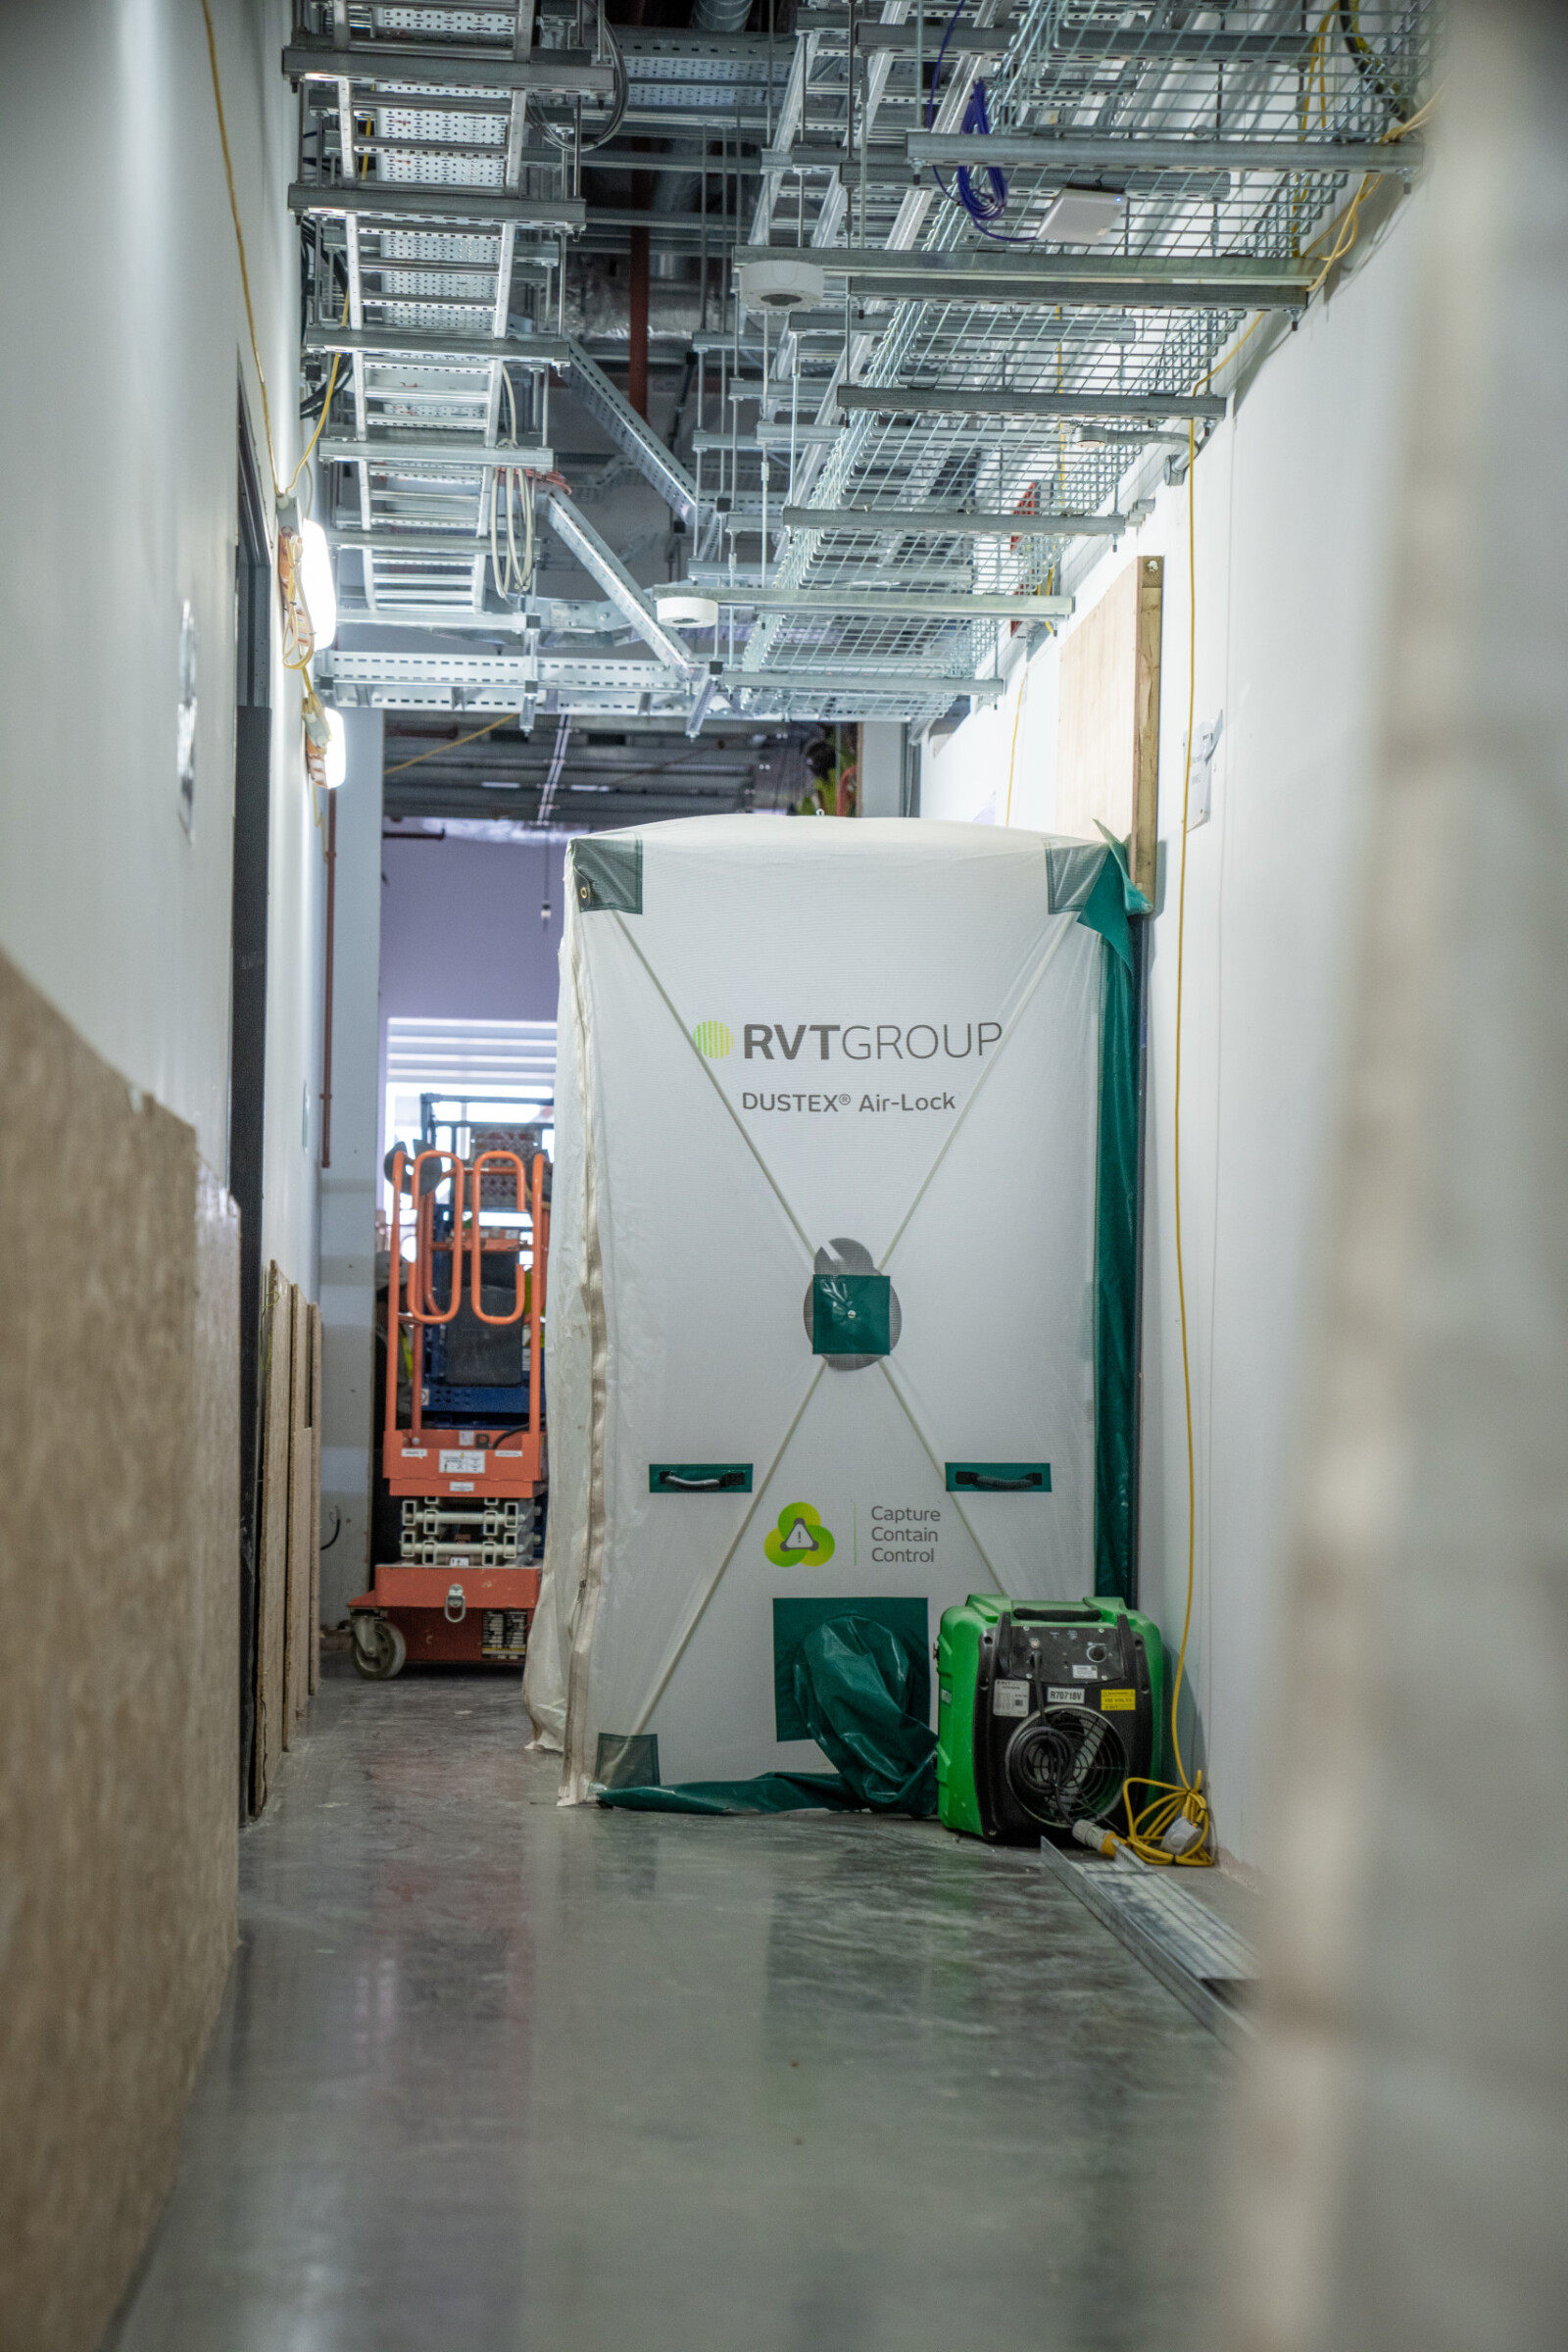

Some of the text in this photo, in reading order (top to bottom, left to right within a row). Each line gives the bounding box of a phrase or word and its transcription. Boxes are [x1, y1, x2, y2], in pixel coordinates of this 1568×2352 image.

[858, 1092, 956, 1112] Air-Lock
[871, 1505, 941, 1524] Capture
[871, 1526, 938, 1543] Contain
[871, 1547, 934, 1563] Control
